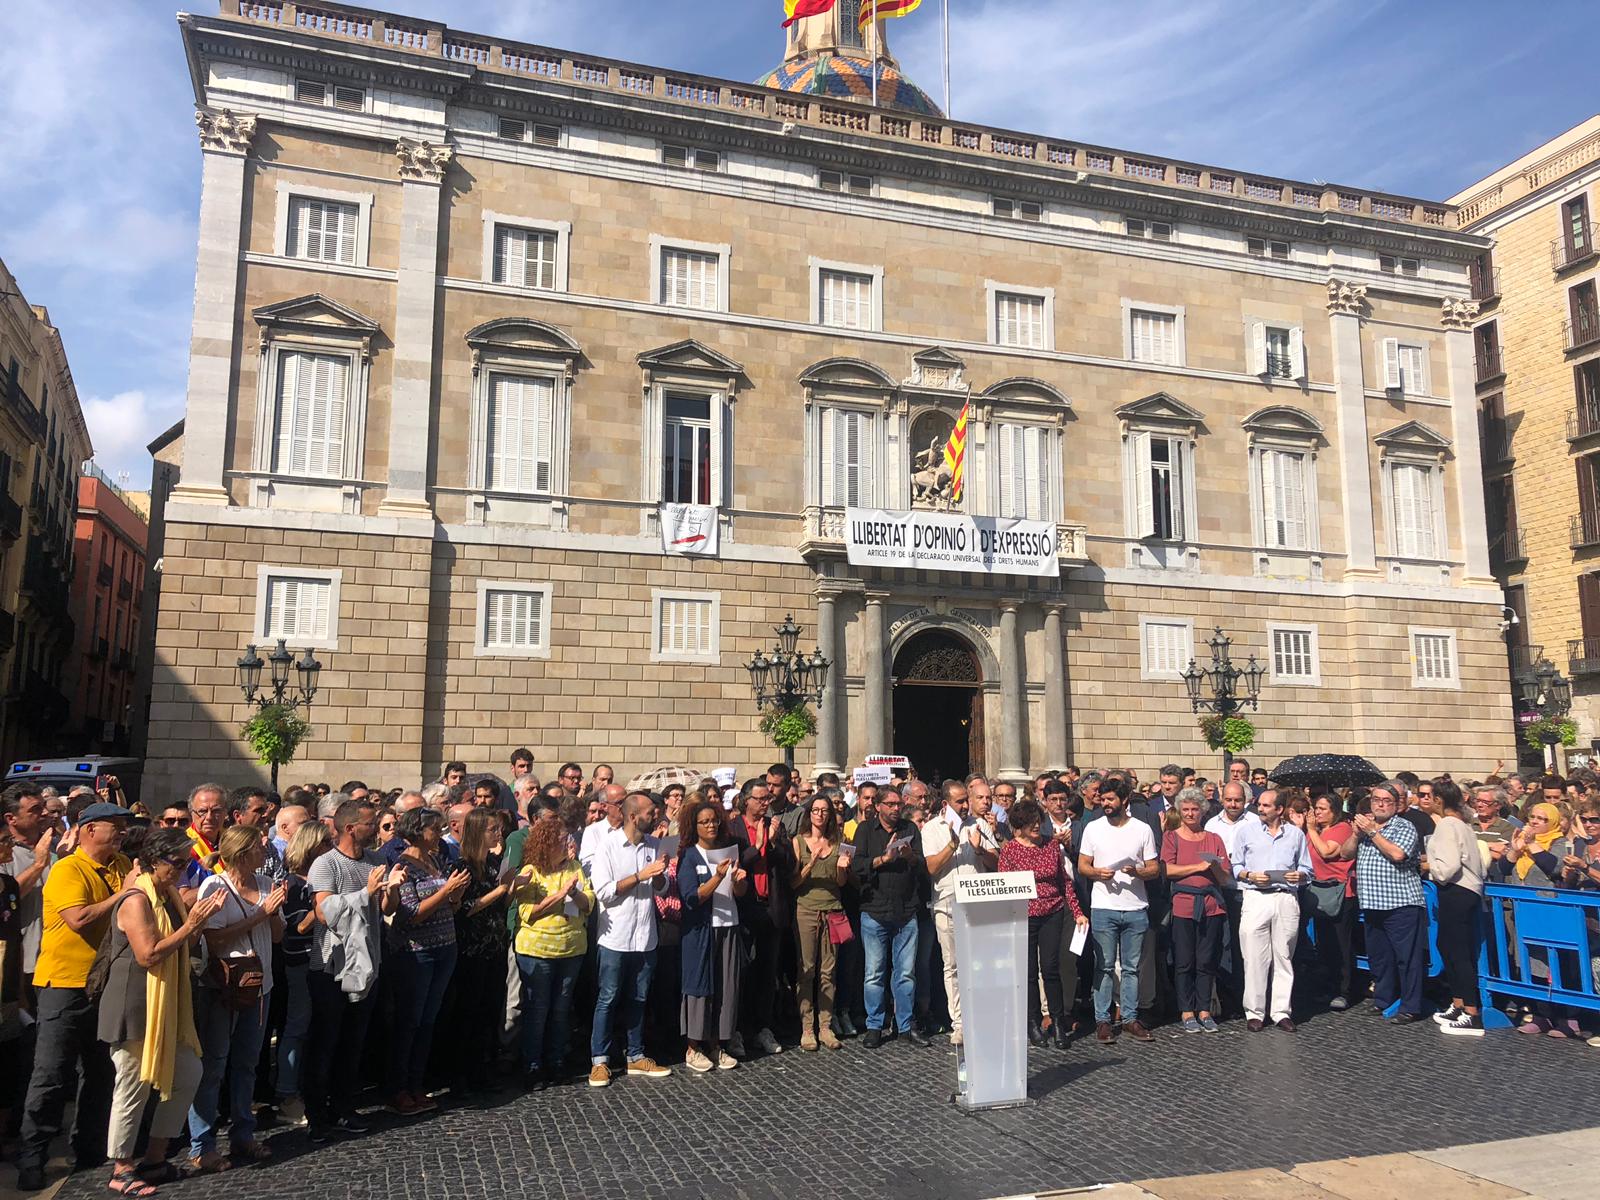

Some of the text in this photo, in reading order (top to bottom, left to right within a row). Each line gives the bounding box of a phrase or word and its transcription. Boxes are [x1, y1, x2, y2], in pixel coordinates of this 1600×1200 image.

[853, 521, 1051, 556] LLIBERTAT D'OPINIÓ I D'EXPRESSIÓ
[867, 549, 888, 557] ARTICLE
[953, 555, 981, 563] UNIVERSAL
[999, 557, 1013, 565] DRETS
[889, 616, 908, 635] PALAU
[950, 609, 992, 638] GENERALITAT
[960, 879, 1005, 888] PELS DRETS
[972, 888, 986, 896] LES
[987, 886, 1032, 895] LLIBERTATS
